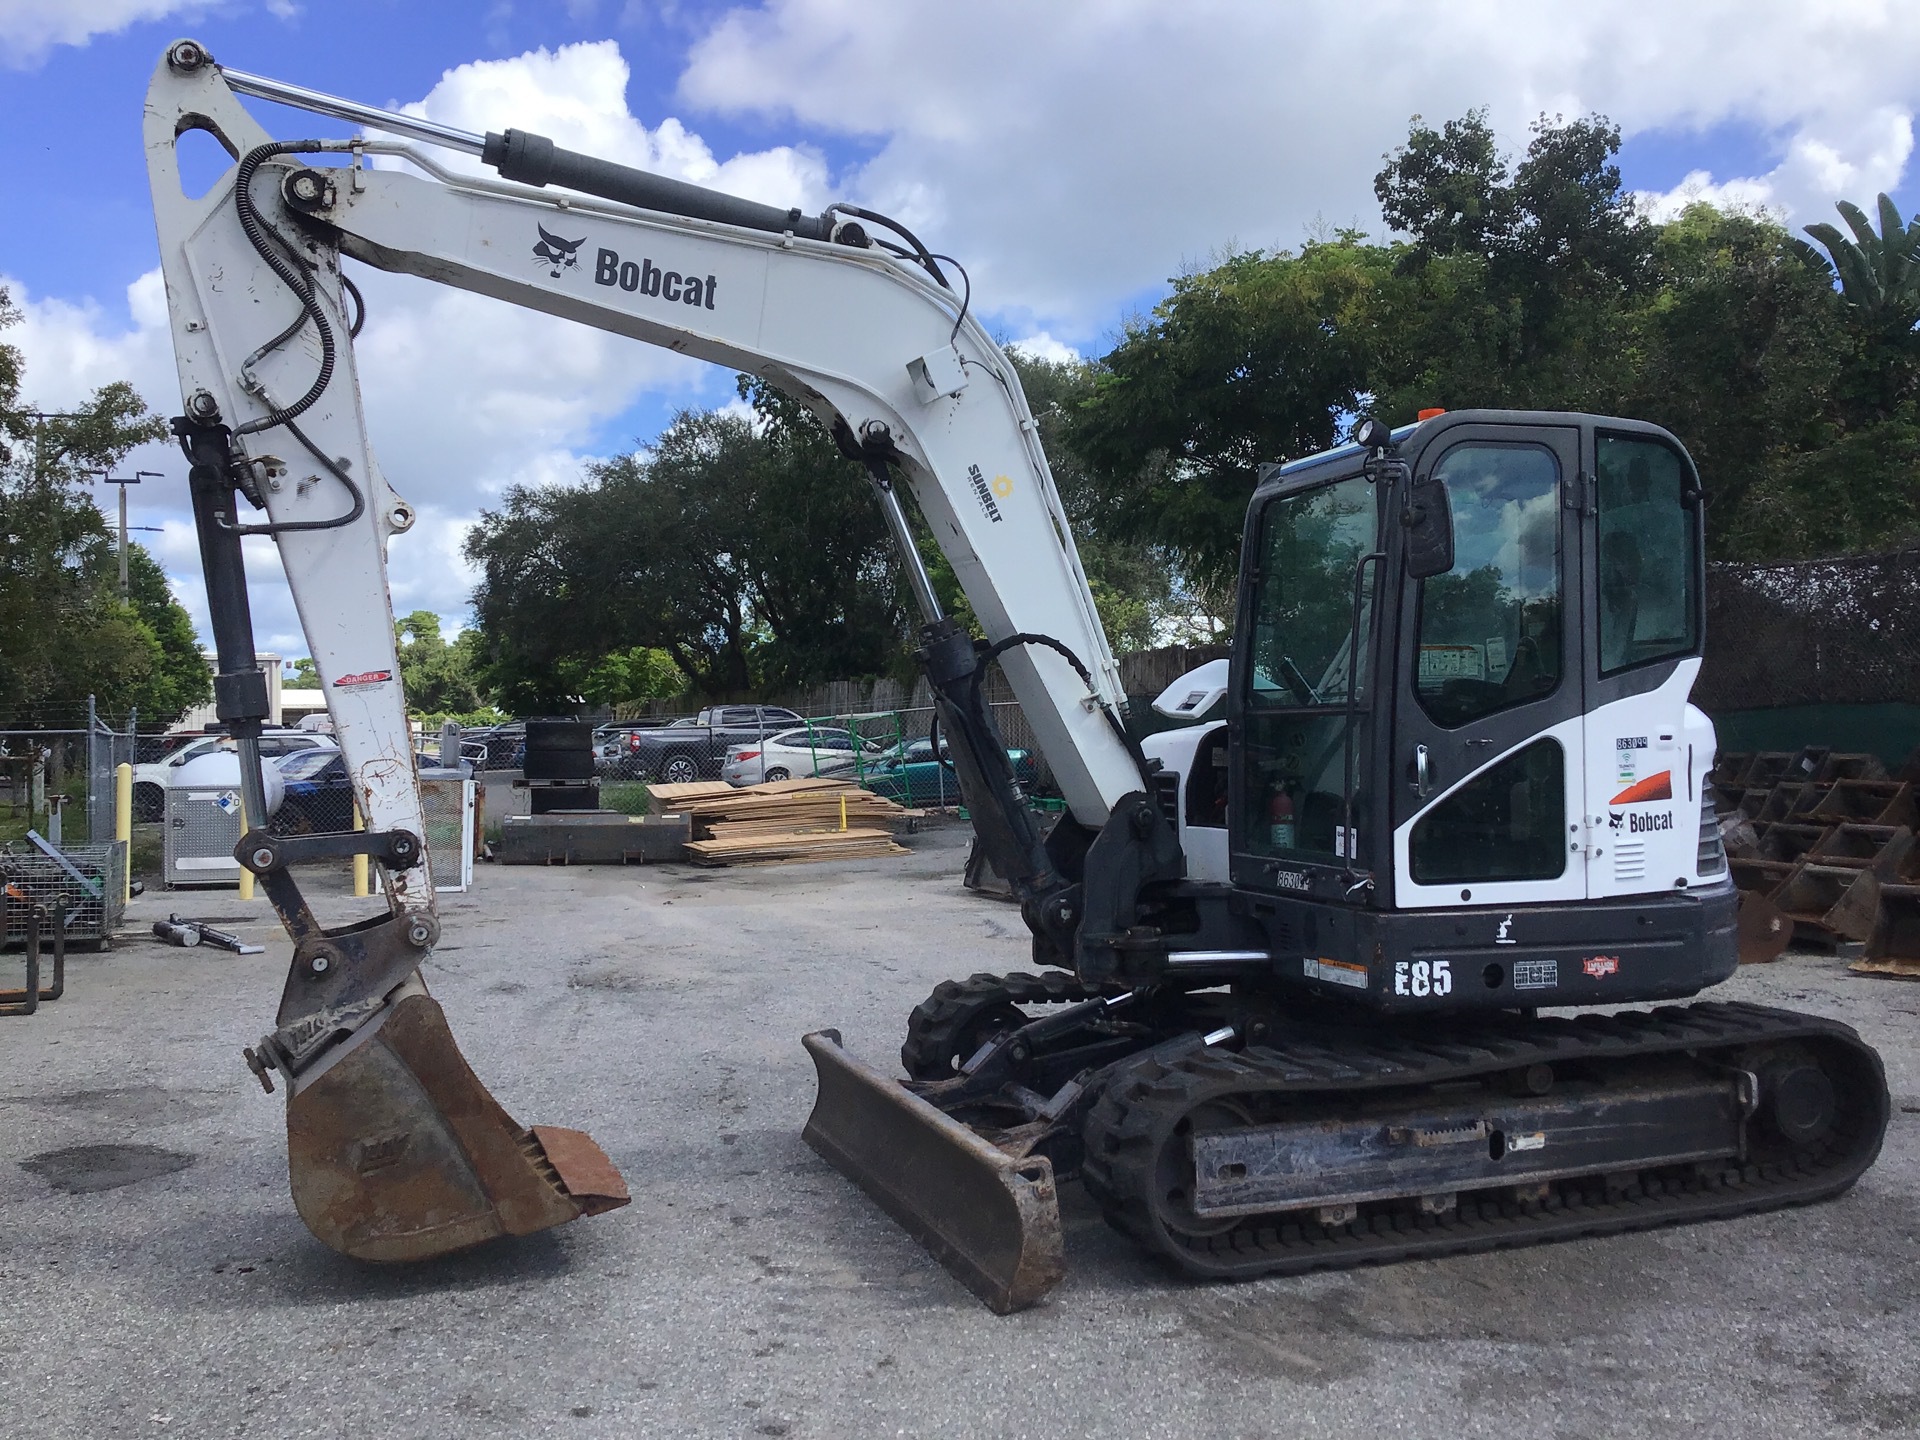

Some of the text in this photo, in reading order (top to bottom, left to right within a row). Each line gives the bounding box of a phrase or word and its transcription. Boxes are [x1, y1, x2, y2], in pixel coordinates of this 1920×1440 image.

[595, 247, 717, 310] Bobcat
[967, 476, 989, 519] RENTALS
[968, 464, 1003, 523] SUNBELT
[346, 673, 379, 683] DANGER
[1617, 737, 1647, 749] 863099
[227, 792, 233, 800] 4
[1630, 811, 1673, 833] Bobcat
[1395, 961, 1452, 997] E85
